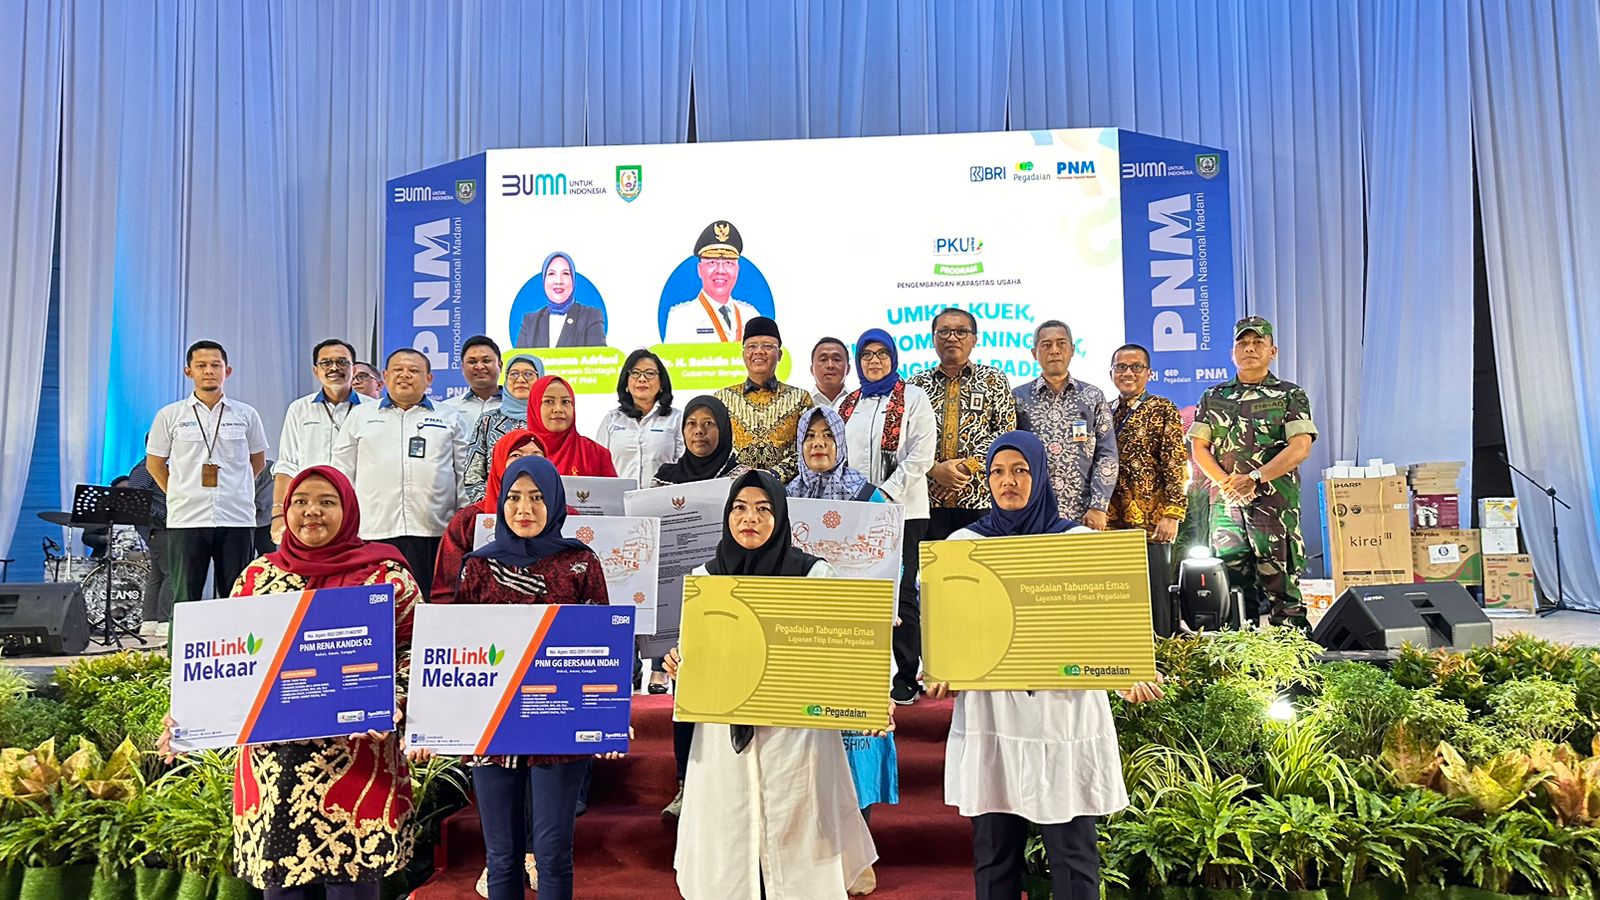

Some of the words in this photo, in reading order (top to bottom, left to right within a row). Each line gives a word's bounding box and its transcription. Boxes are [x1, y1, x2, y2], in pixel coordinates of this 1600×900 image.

[985, 166, 1006, 180] BRI
[1056, 160, 1096, 175] PNM
[1122, 161, 1166, 178] BUMN
[502, 173, 567, 196] BUMN
[1013, 173, 1051, 183] Pegadaian
[394, 186, 431, 203] BUMN
[569, 187, 607, 195] INDONESIA
[1194, 192, 1206, 232] Madani
[452, 216, 462, 256] Madani
[936, 237, 970, 253] PKU
[1197, 235, 1208, 282] Nasional
[1148, 193, 1198, 352] PNM
[452, 258, 462, 304] Nasional
[897, 281, 954, 289] PENGEMBANGAN
[412, 217, 450, 370] PNM
[968, 301, 1035, 323] KUEK,
[1200, 285, 1211, 351] Permodalan
[452, 307, 462, 370] Permodalan
[990, 359, 1043, 377] PADE
[1195, 367, 1229, 380] PNM
[1349, 535, 1383, 547] kirei
[1020, 583, 1063, 595] Pegadaian
[1063, 582, 1104, 593] Tabungan
[1105, 580, 1130, 590] Emas
[1035, 594, 1062, 603] Layanan
[1062, 593, 1077, 602] Titip
[1079, 592, 1096, 600] Emas
[1096, 592, 1130, 601] Pegadaian
[775, 624, 814, 635] Pegadaian
[815, 625, 852, 637] Tabungan
[853, 626, 875, 636] Emas
[184, 636, 247, 660] BRILink
[299, 642, 316, 652] PNM
[316, 640, 335, 650] RENA
[336, 638, 363, 649] KANDIS
[362, 637, 373, 646] 02
[788, 635, 813, 644] Layanan
[813, 636, 827, 645] Titip
[844, 637, 875, 646] Pegadaian
[423, 646, 488, 665] BRILink
[534, 659, 551, 668] PNM
[551, 659, 562, 668] GG
[563, 659, 596, 667] BERSAMA
[596, 658, 620, 667] INDAH
[183, 659, 258, 682] Mekaar
[422, 667, 499, 688] Mekaar
[1084, 665, 1131, 677] Pegadaian
[825, 706, 867, 719] Pegadaian
[842, 737, 871, 751] SHION
